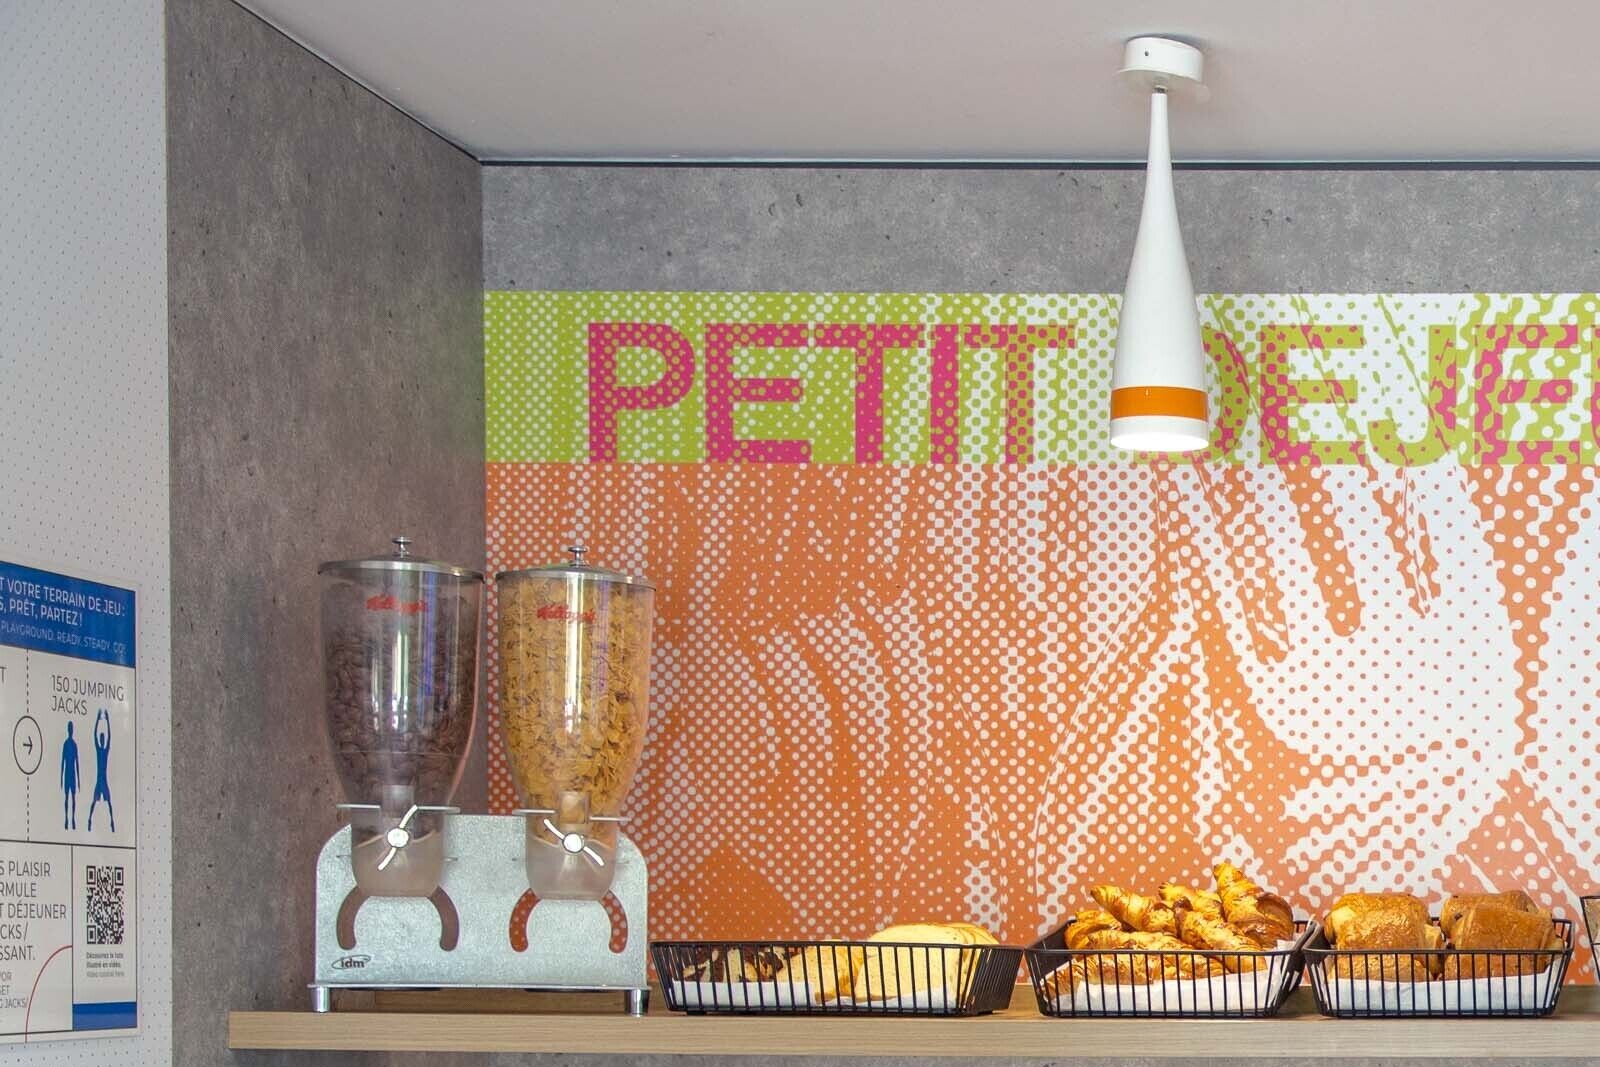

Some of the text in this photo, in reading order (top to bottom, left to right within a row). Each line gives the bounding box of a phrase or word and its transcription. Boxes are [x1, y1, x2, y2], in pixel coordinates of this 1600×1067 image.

[588, 322, 1075, 464] PETIT
[8, 580, 41, 599] VOTRE
[44, 586, 85, 609] TERRAIN
[88, 596, 101, 613] DE
[52, 674, 124, 702] 150 JUMPING
[51, 695, 88, 716] JACKS
[8, 861, 51, 877] PLAISIR
[8, 901, 67, 919] DÉJEUNER
